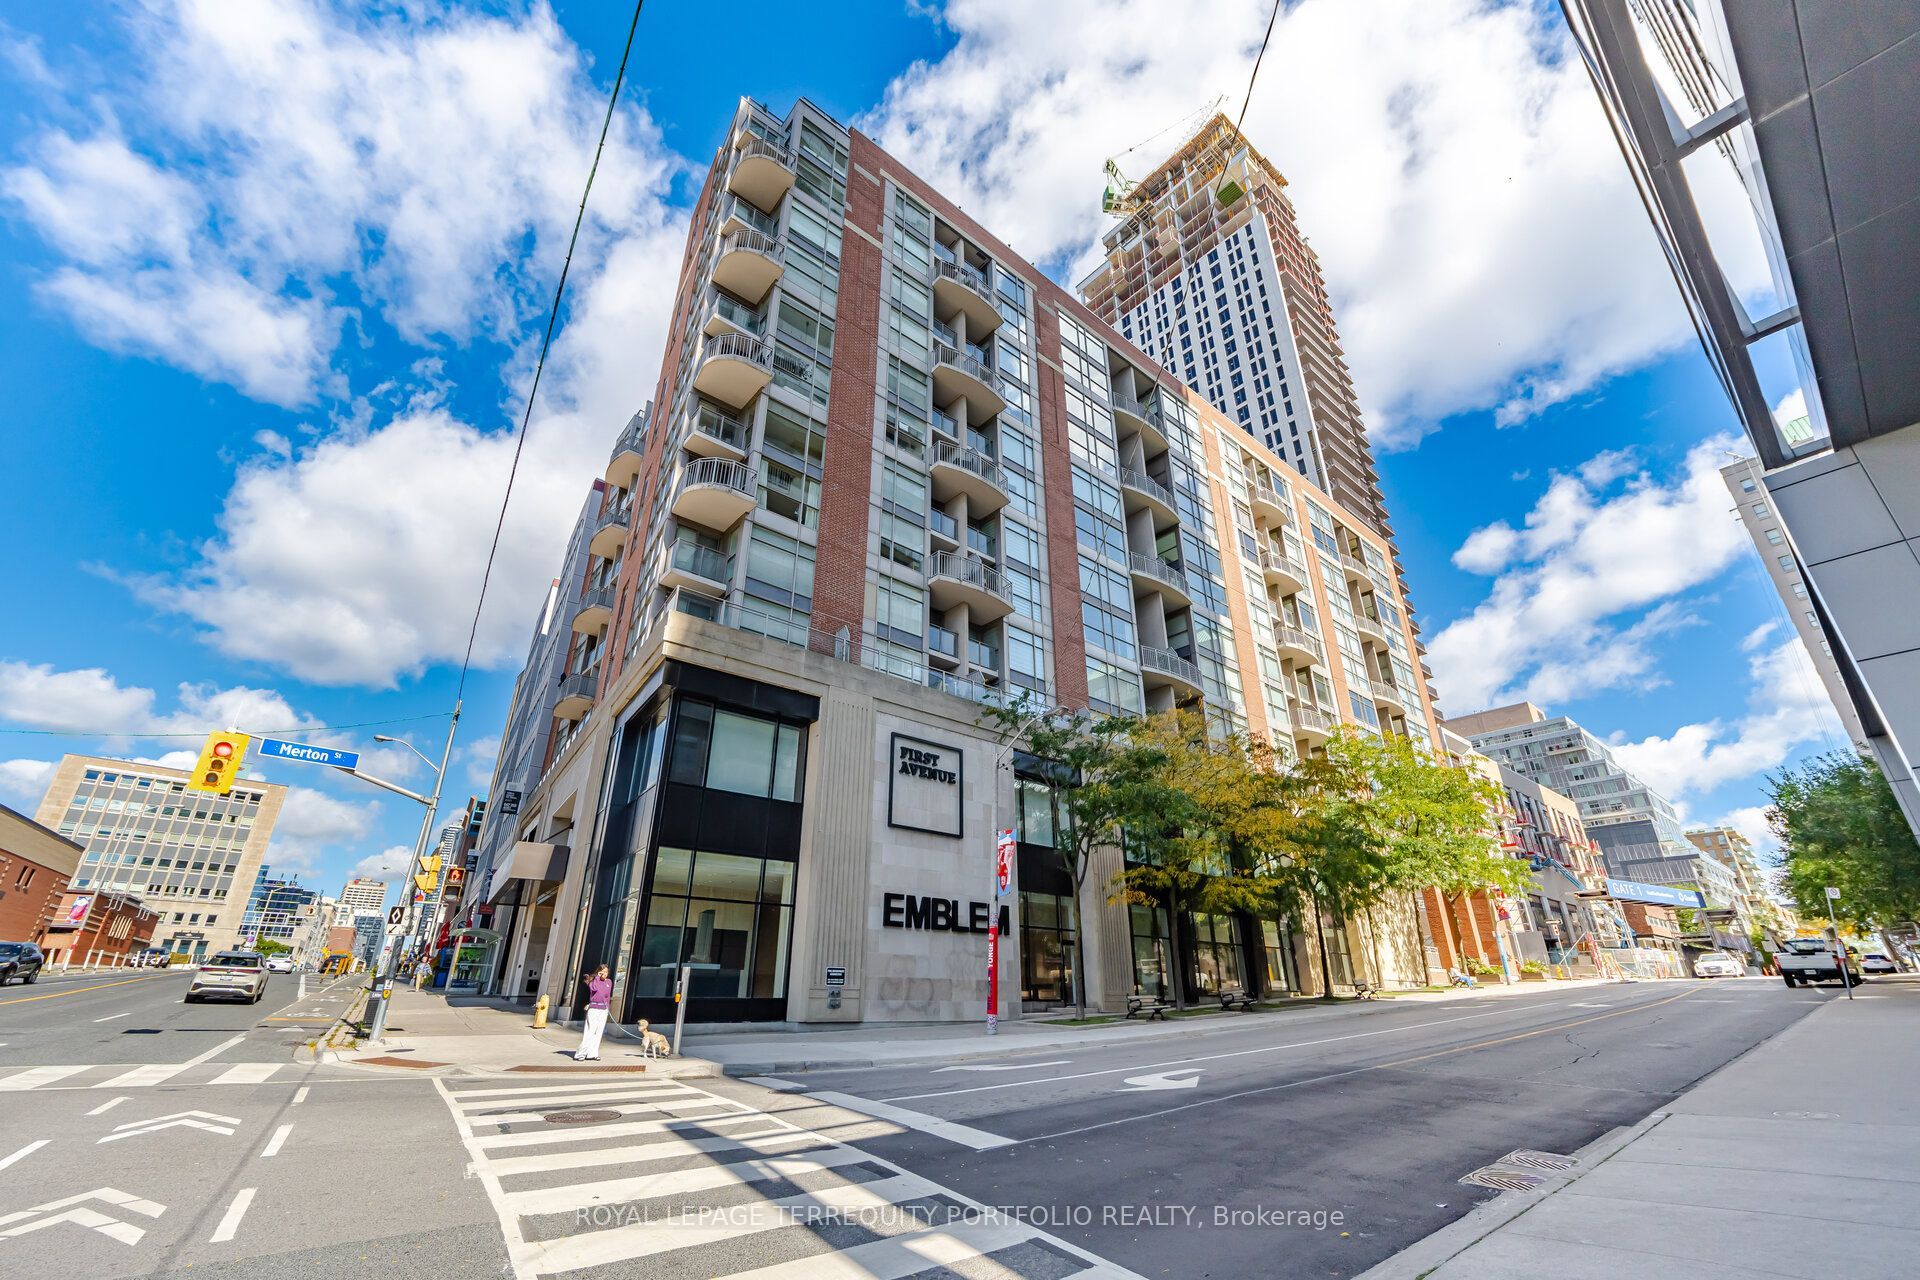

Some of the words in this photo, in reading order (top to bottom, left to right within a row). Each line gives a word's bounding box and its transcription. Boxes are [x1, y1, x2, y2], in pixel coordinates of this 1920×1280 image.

[279, 743, 329, 762] Merton
[900, 746, 940, 767] FIRST
[899, 761, 957, 784] AVENUE
[1612, 882, 1637, 896] GATE
[1637, 886, 1643, 897] 1
[883, 892, 1010, 936] EMBLEM
